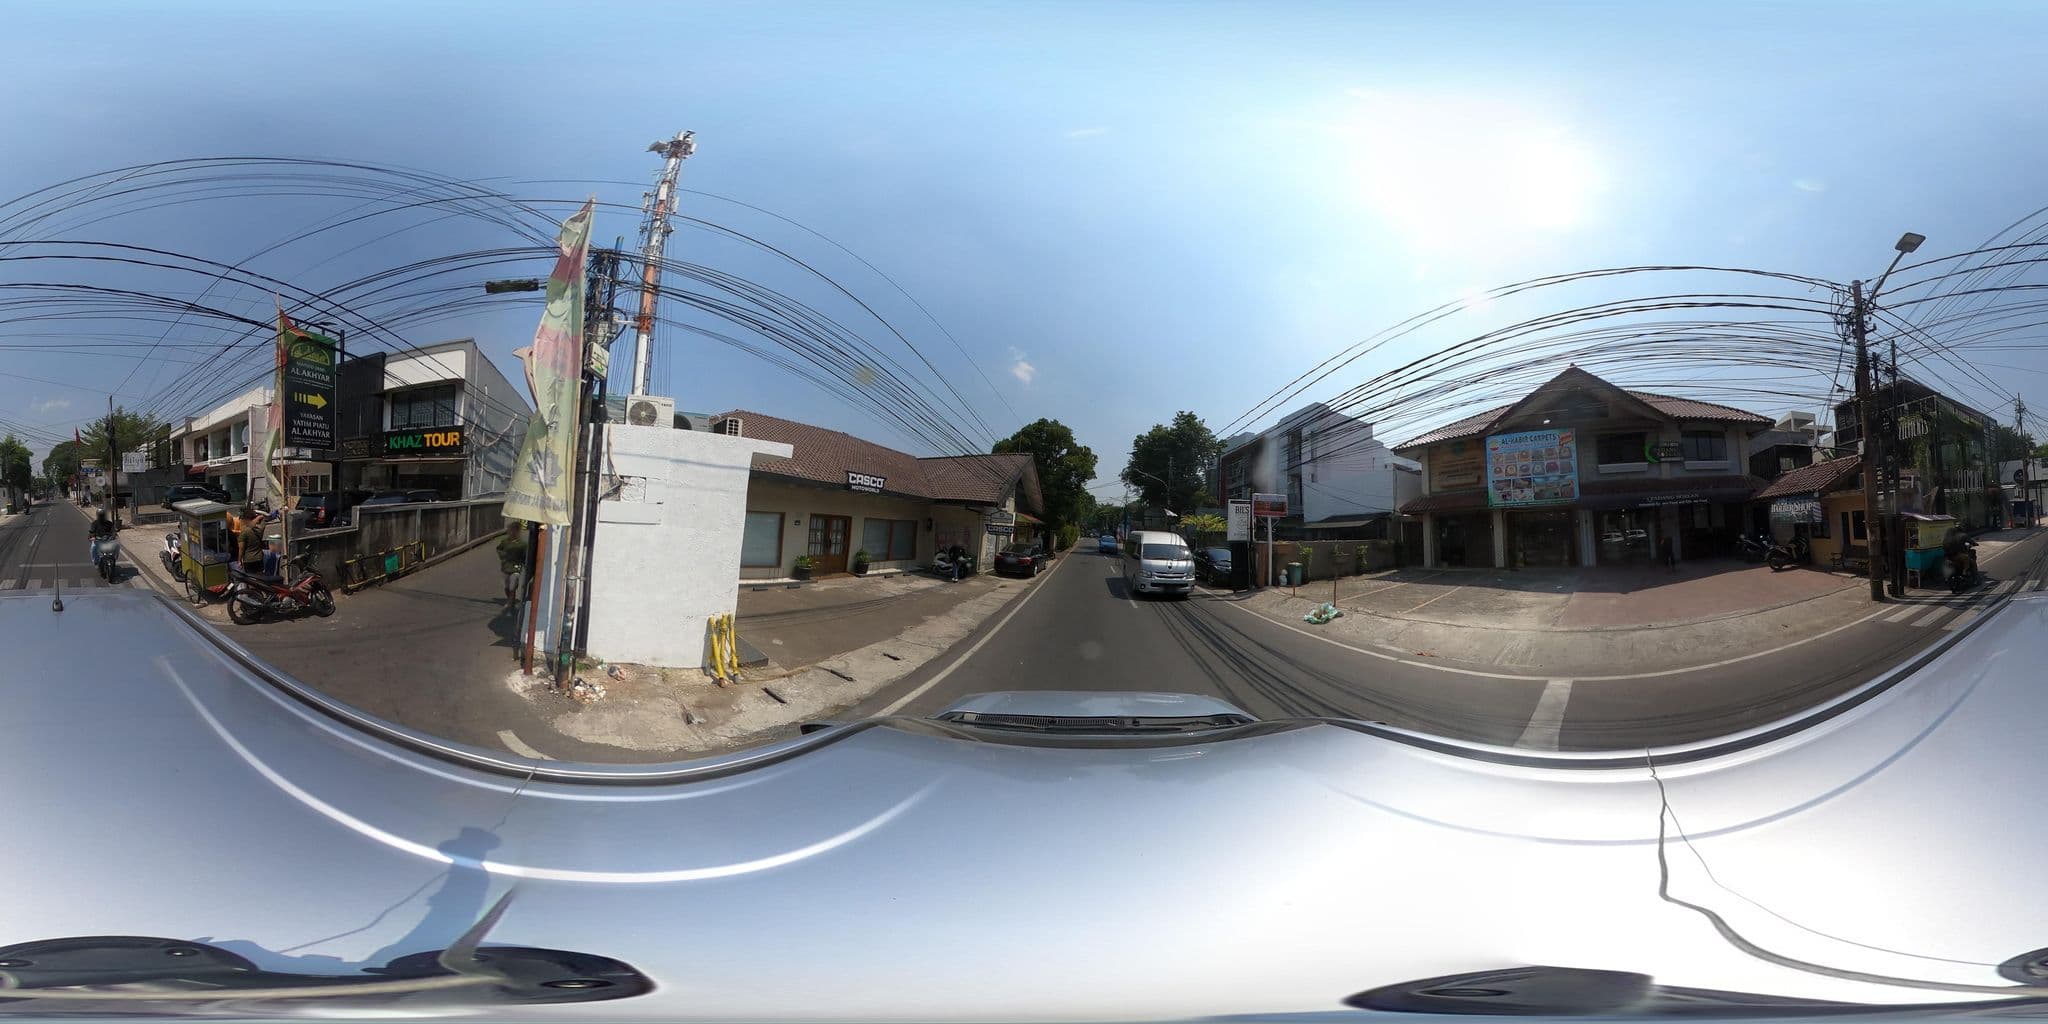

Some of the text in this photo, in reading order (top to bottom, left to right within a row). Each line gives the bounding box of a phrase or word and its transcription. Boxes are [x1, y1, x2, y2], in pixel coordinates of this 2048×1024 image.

[291, 367, 330, 382] AL AKHYAR
[291, 427, 331, 439] AL AKHYAR
[1530, 433, 1558, 443] CARPETS
[389, 431, 460, 449] KHAZ TOUR
[848, 472, 885, 488] CASCO
[987, 525, 1013, 534] CASCO
